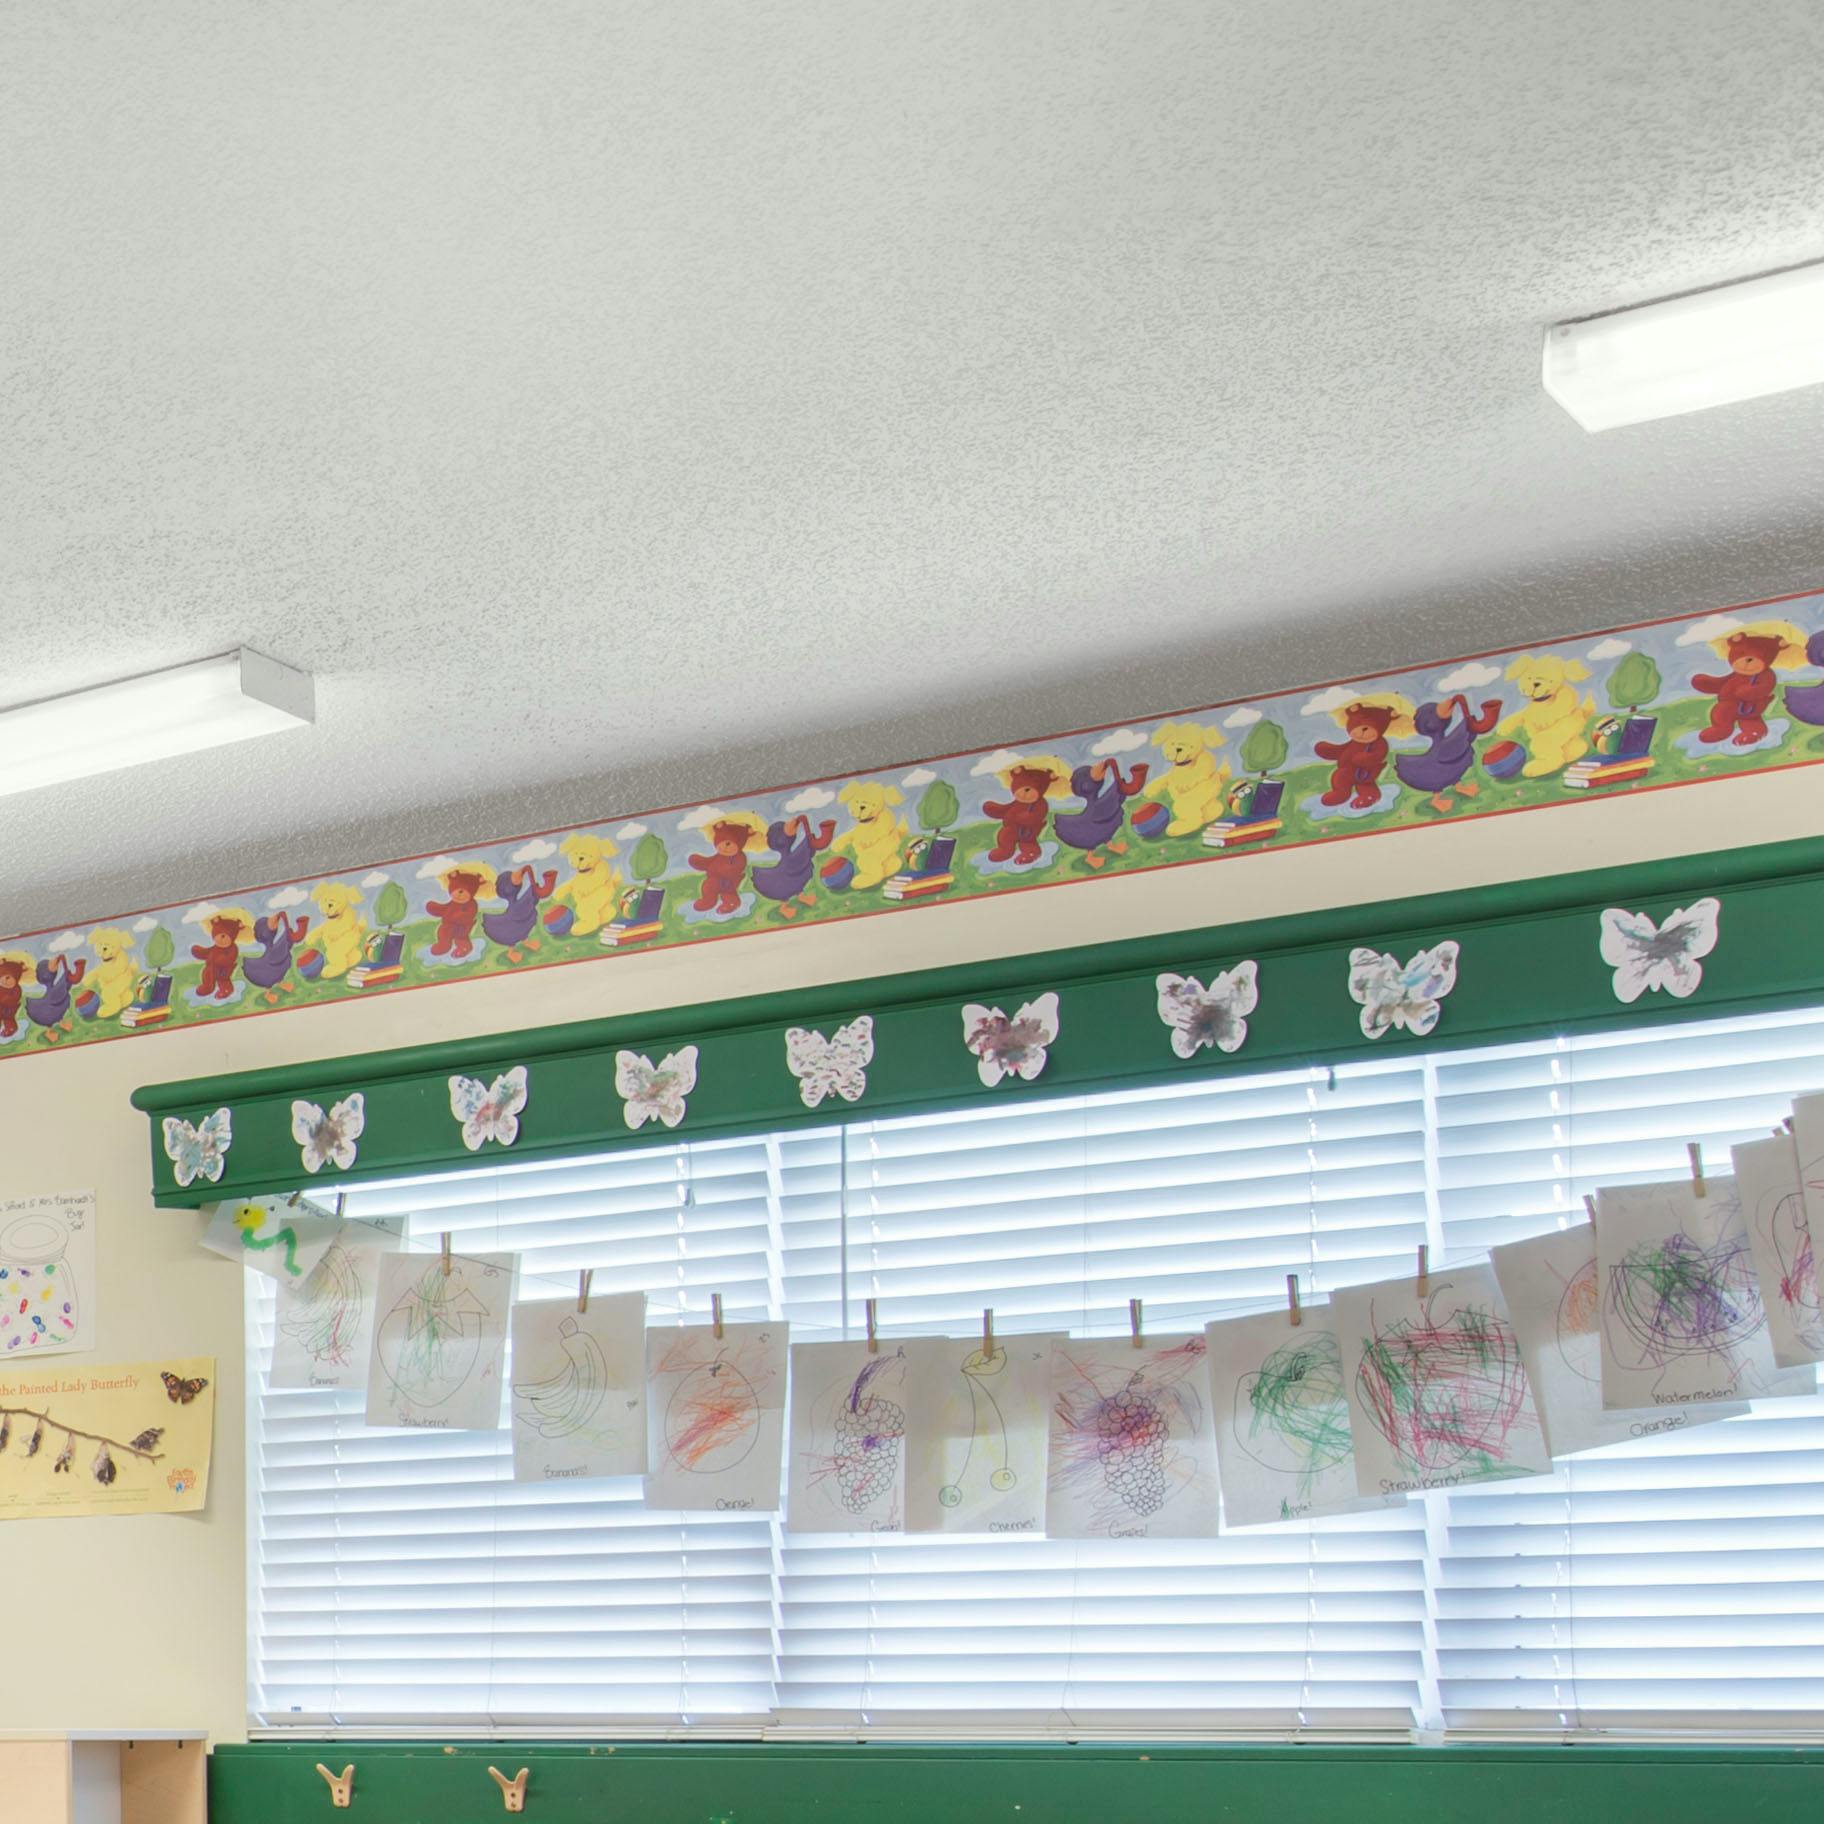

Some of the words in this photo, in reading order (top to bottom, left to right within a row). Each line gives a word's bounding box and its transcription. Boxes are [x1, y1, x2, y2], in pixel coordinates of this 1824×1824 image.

[19, 1380, 58, 1395] Painted
[61, 1379, 87, 1395] Lady
[90, 1375, 140, 1391] Butterfly
[1654, 1385, 1738, 1404] Watermelon!
[1630, 1411, 1689, 1437] Orange!
[1379, 1470, 1466, 1495] Strawberry!
